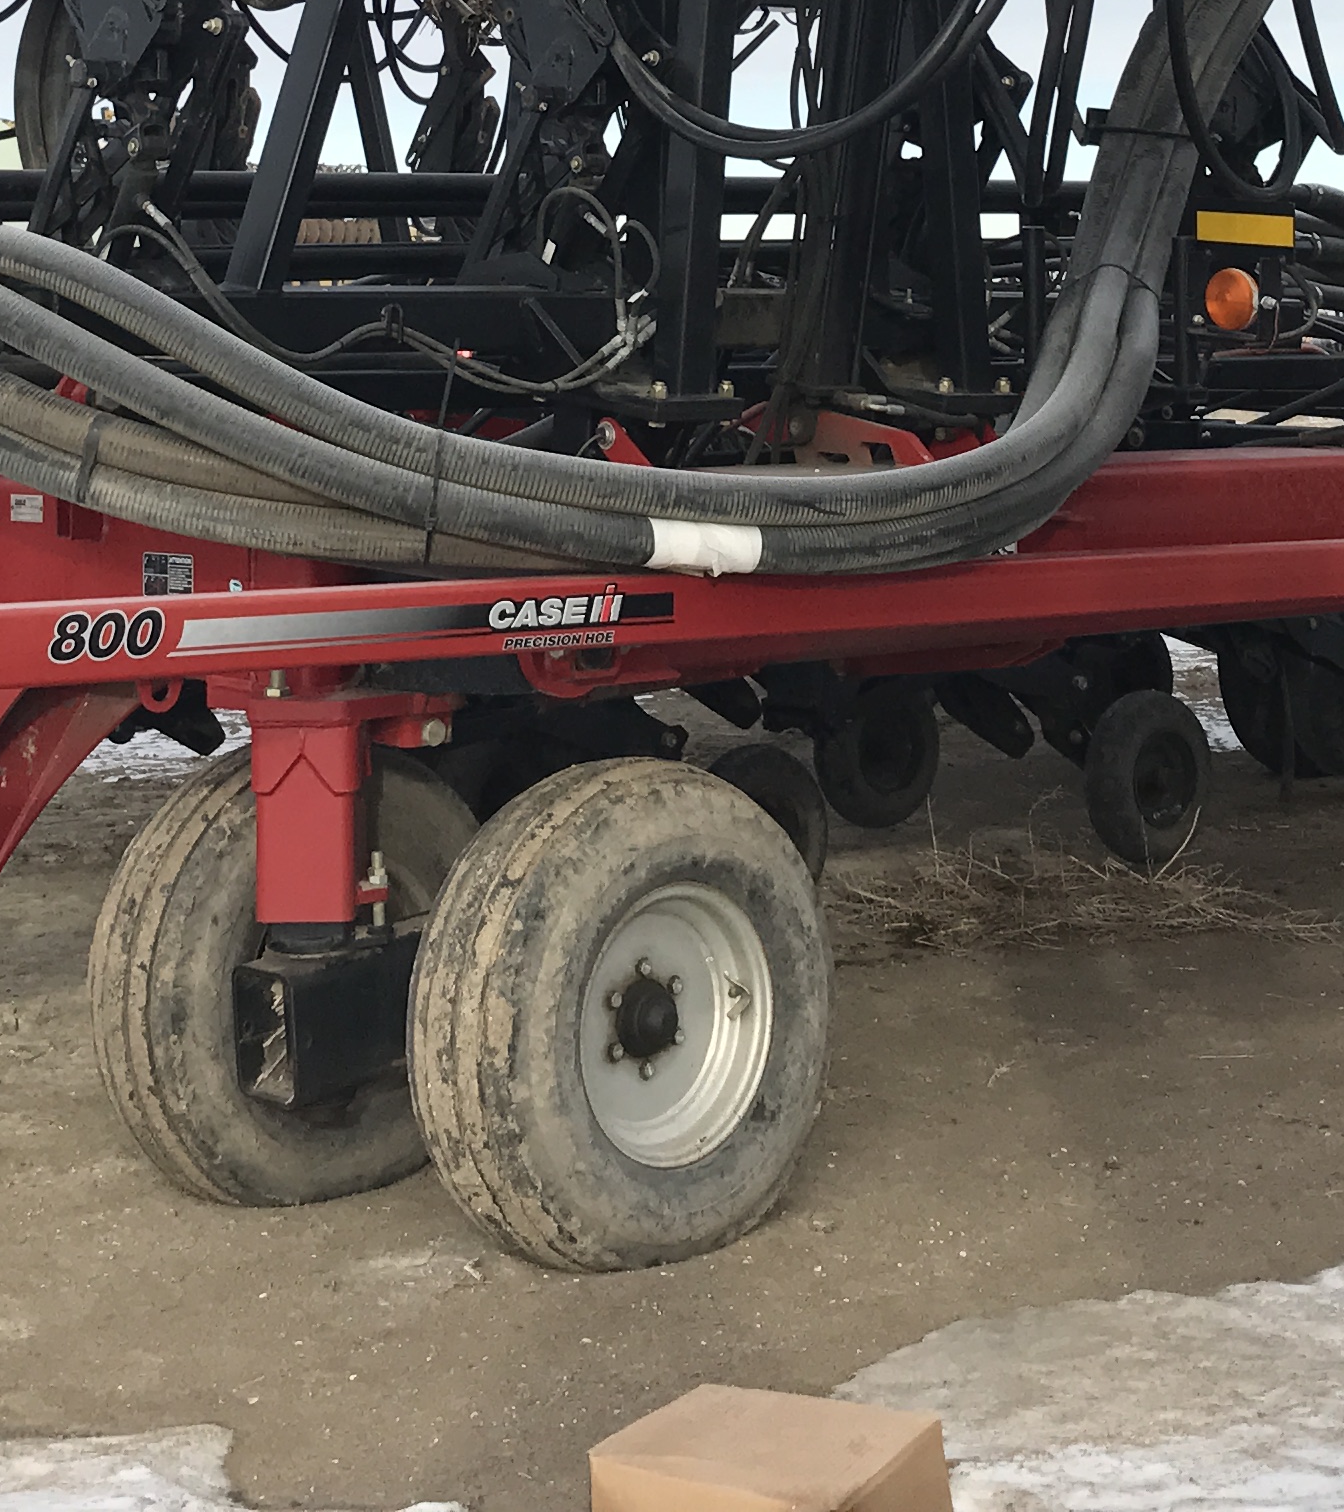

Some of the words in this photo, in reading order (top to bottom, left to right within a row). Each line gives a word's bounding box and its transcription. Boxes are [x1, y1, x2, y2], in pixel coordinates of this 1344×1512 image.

[48, 607, 165, 664] 800
[503, 632, 582, 650] PRECISION
[584, 630, 615, 645] HOE
